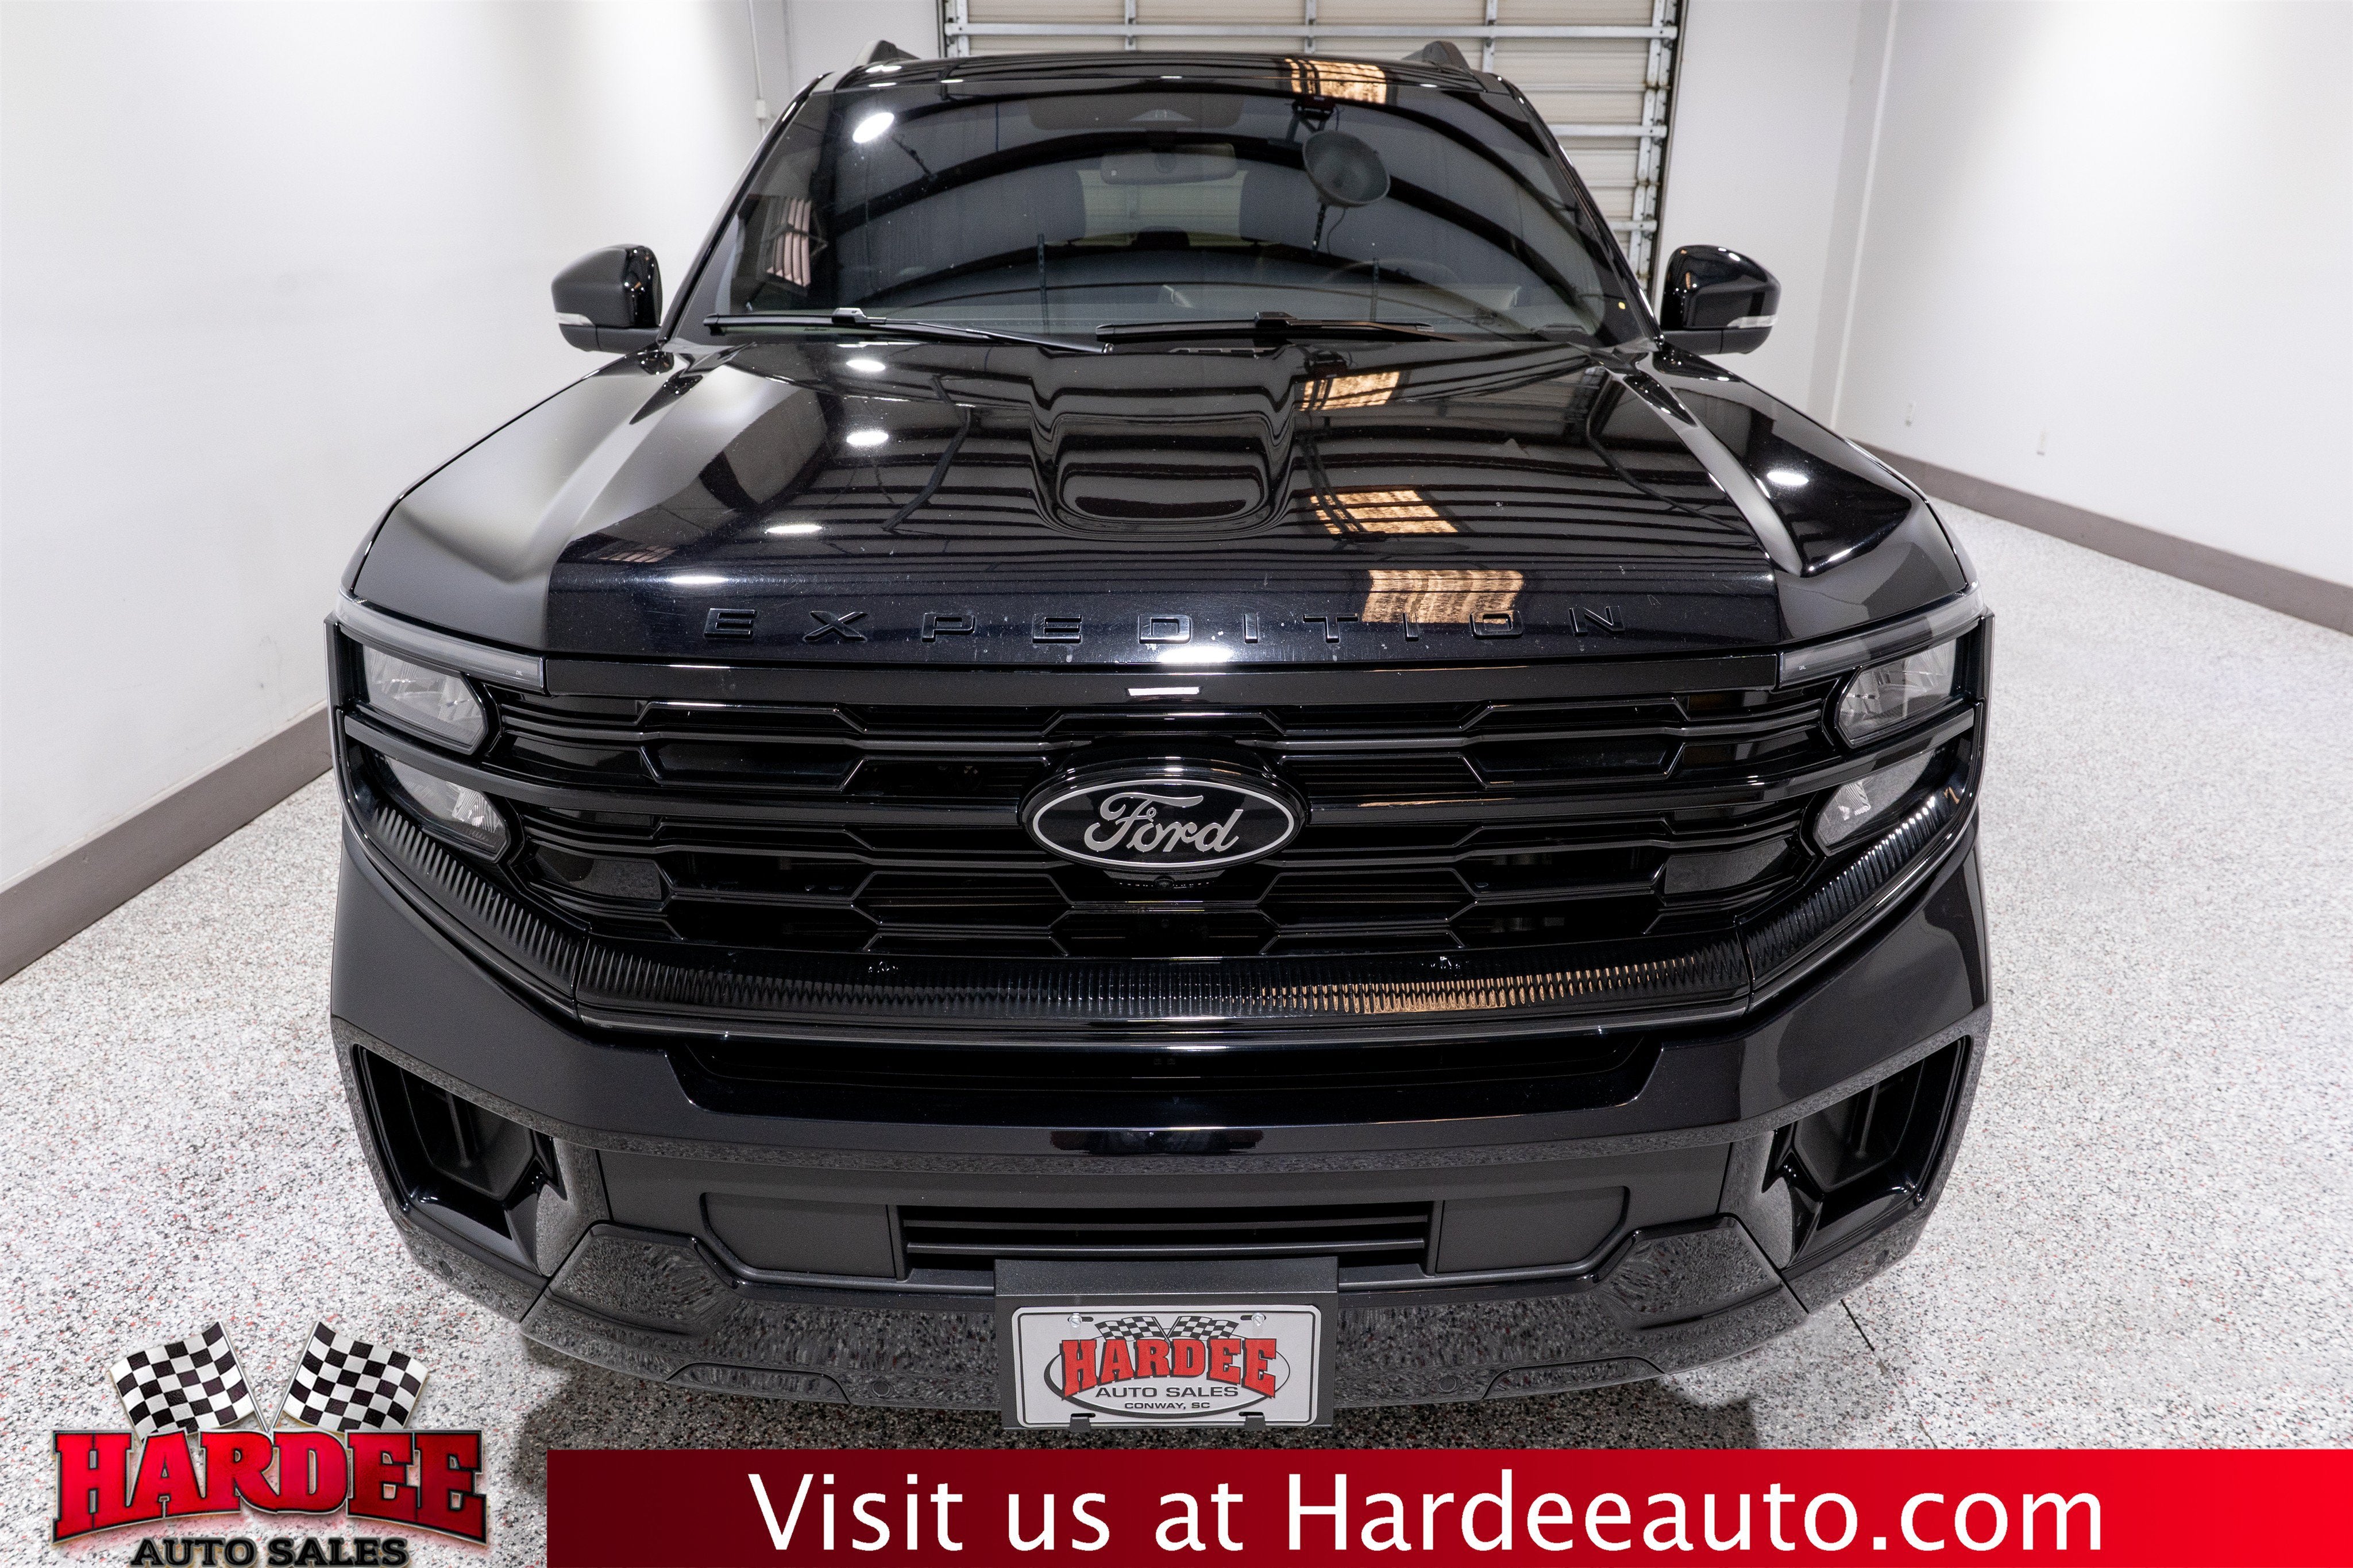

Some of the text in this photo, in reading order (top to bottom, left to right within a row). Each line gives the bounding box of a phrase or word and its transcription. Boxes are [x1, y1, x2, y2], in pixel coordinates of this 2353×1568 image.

[703, 606, 1626, 643] EXPEDITION
[1084, 792, 1244, 852] Ford
[1060, 1338, 1276, 1400] HARDEE
[1095, 1386, 1239, 1398] AUTO SALES
[1124, 1402, 1187, 1411] CONWAY,
